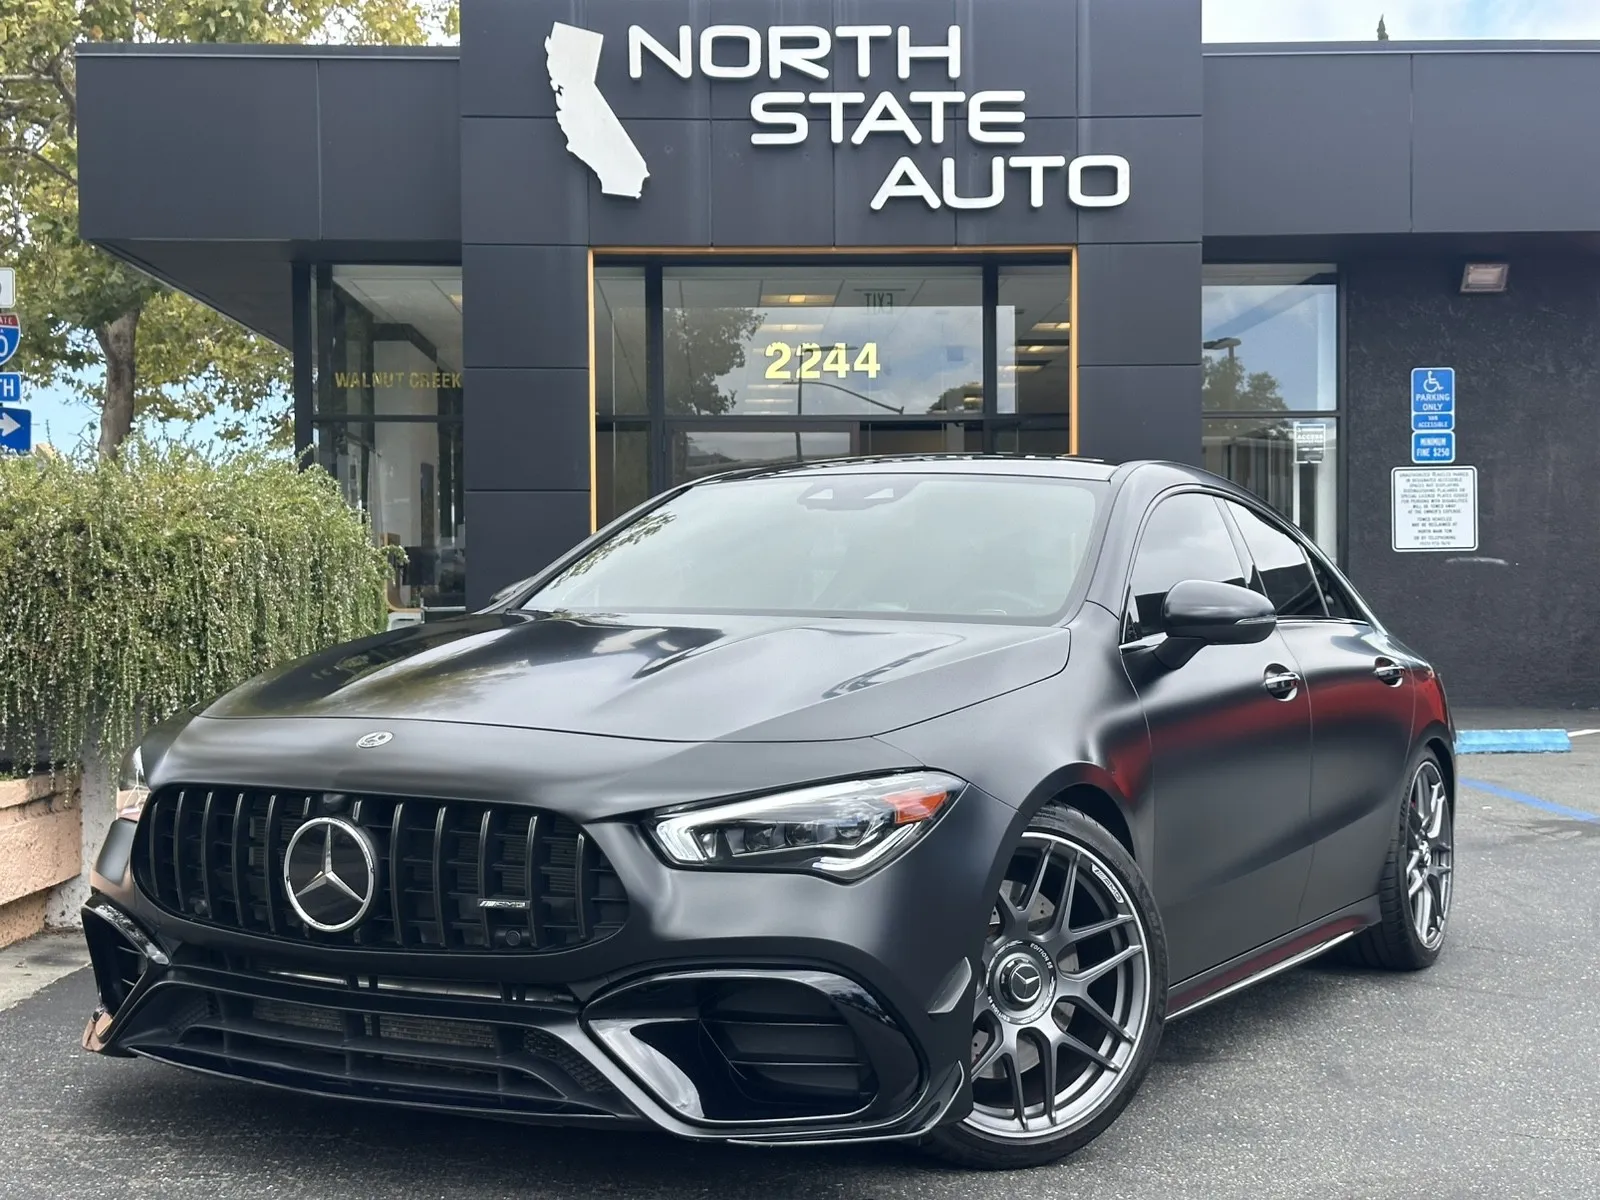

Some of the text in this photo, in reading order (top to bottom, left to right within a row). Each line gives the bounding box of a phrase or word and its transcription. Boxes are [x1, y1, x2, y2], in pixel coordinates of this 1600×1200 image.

[628, 25, 961, 81] NORTH
[750, 91, 1026, 145] STATE
[870, 155, 1131, 210] AUTO
[765, 341, 881, 379] 2244
[335, 372, 462, 388] WALNUT CREEK
[1416, 393, 1450, 401] PARKING
[1422, 403, 1443, 411] ONLY
[1416, 448, 1450, 457] FINE $250
[1030, 942, 1049, 961] EDITION
